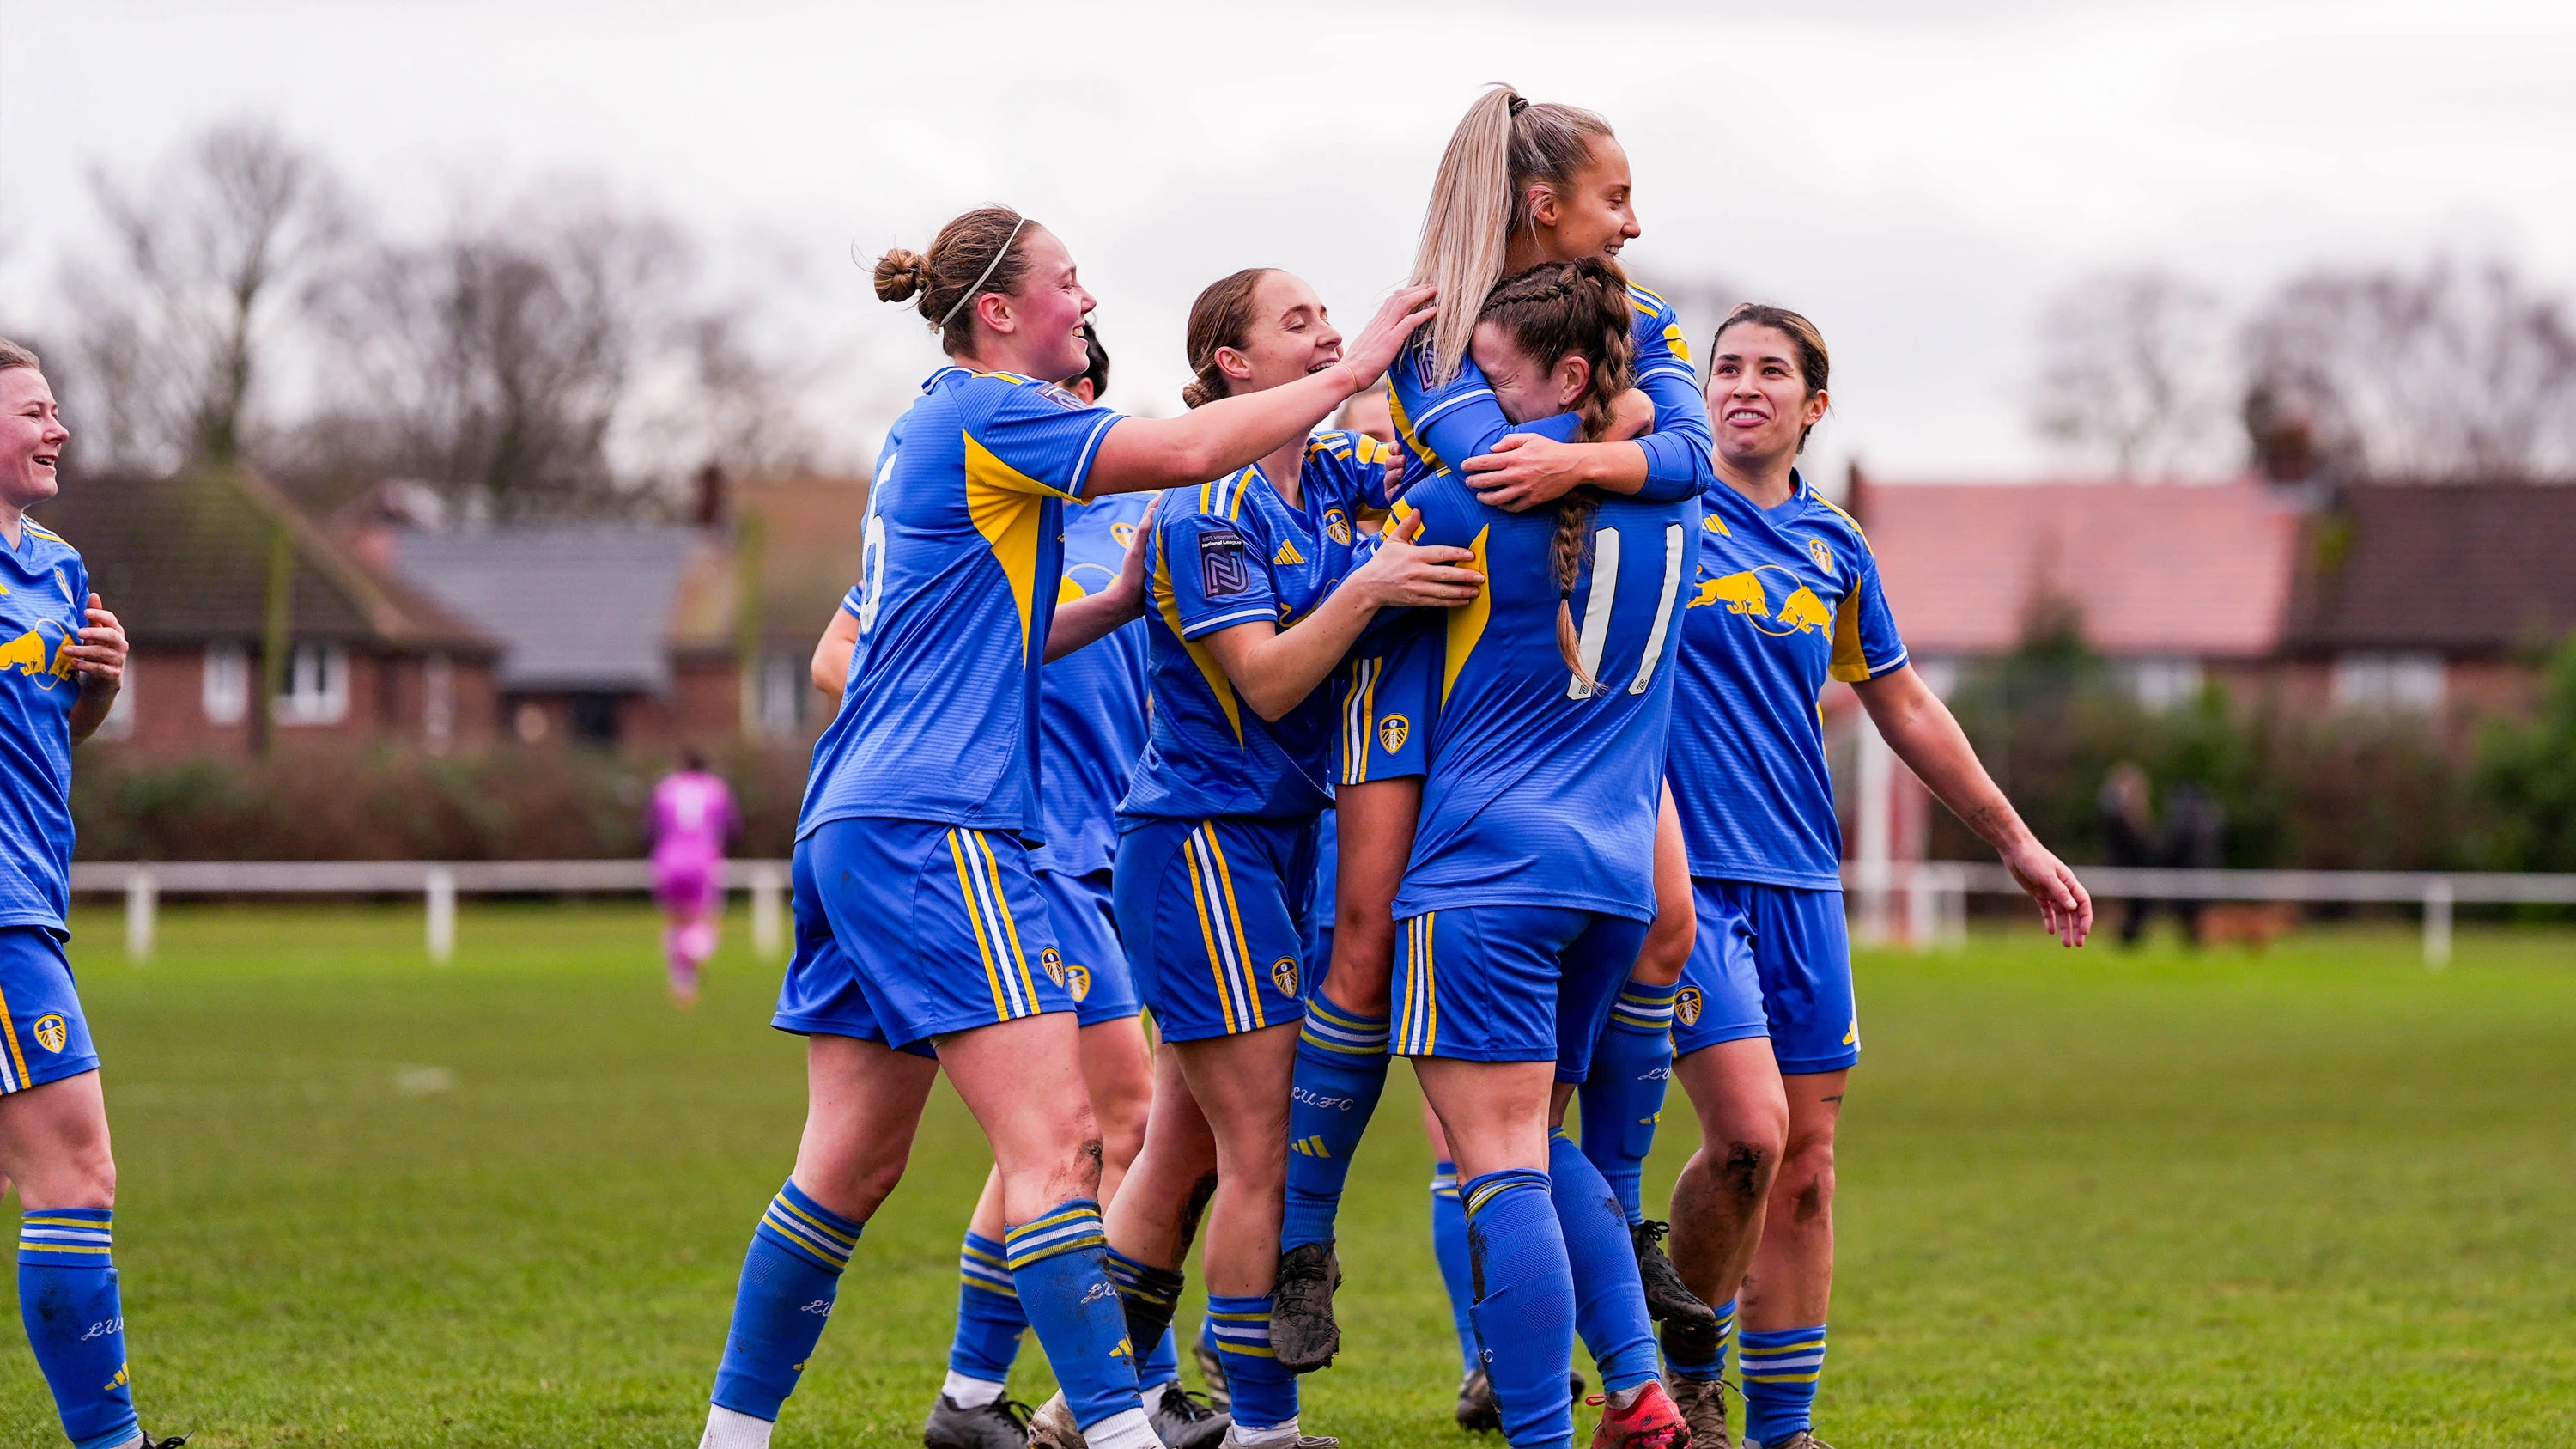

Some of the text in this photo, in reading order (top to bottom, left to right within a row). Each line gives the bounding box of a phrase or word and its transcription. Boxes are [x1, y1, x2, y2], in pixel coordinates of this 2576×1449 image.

[860, 452, 898, 634] 6
[1566, 523, 1685, 701] 11
[1637, 1067, 1671, 1080] LU
[1291, 1086, 1354, 1111] LUFC
[1080, 1282, 1118, 1304] LU
[800, 1300, 834, 1318] LU
[81, 1316, 125, 1341] LU
